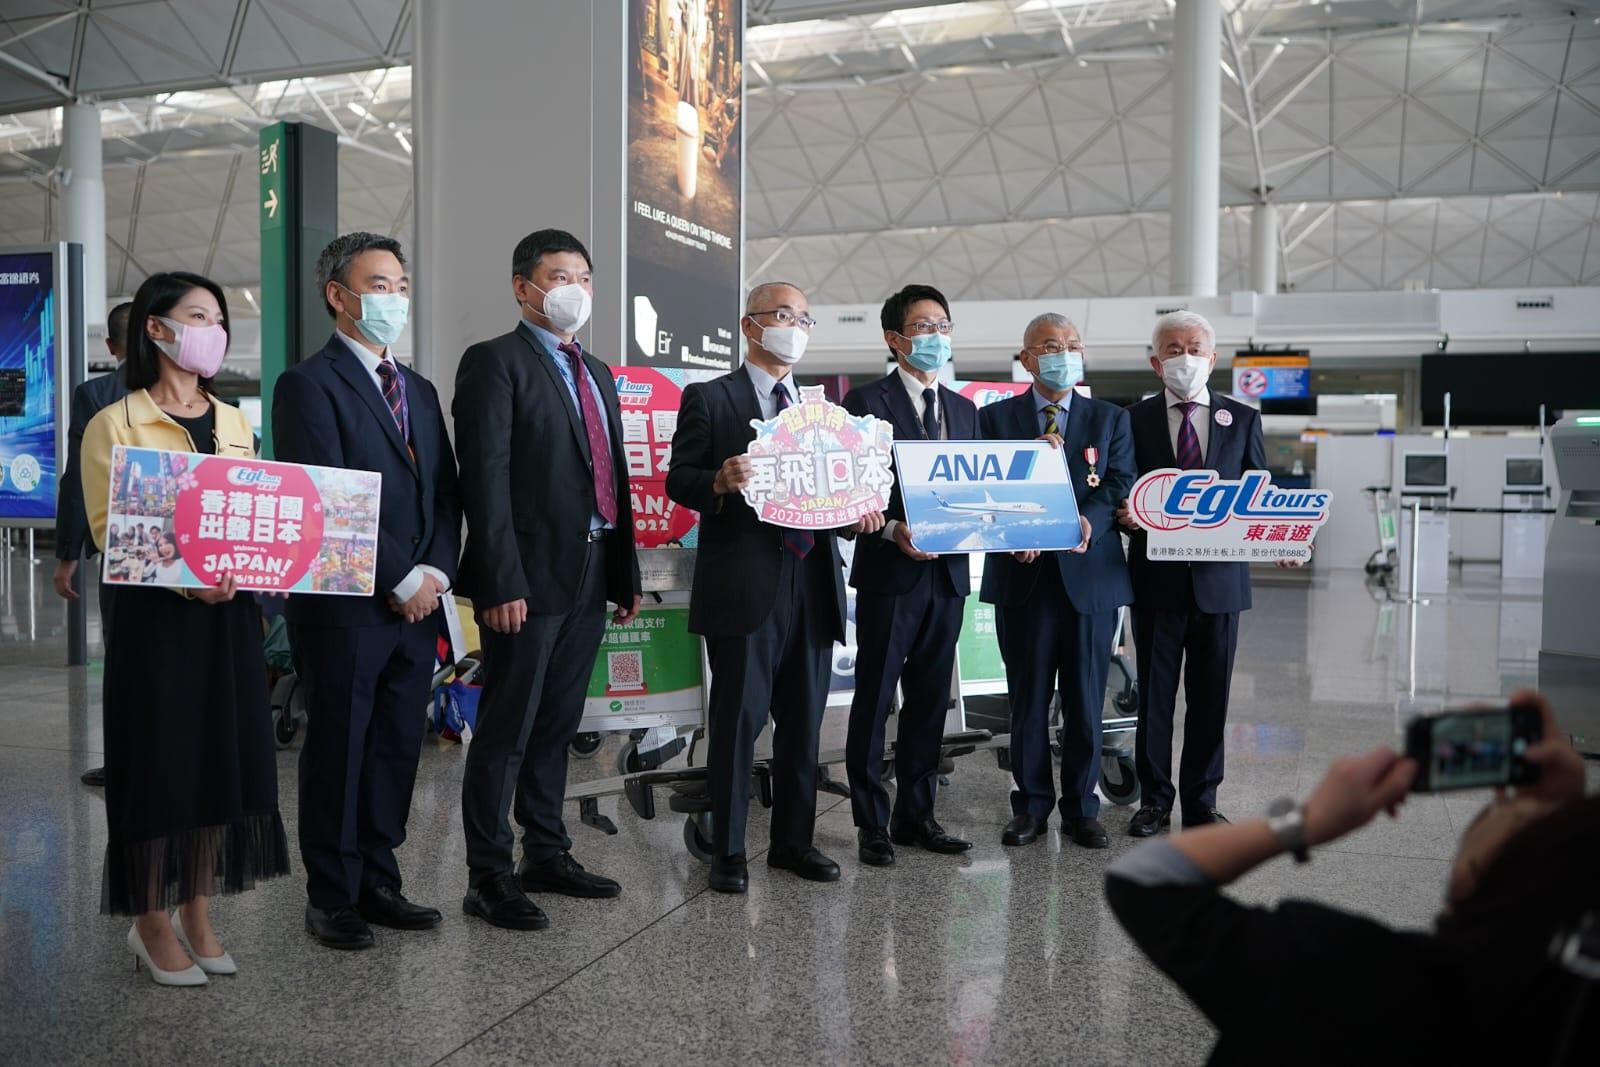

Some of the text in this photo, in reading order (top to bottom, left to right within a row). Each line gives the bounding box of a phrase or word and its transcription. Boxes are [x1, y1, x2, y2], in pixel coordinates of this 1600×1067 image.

[638, 202, 652, 219] FEEL
[652, 208, 666, 224] LIKE
[671, 216, 690, 233] QUEEN
[690, 223, 699, 236] ON
[626, 382, 651, 391] tours
[928, 454, 1004, 482] ANA
[200, 489, 304, 520] 香港首團
[800, 497, 848, 512] JAPAN!
[1262, 489, 1328, 508] tours
[198, 514, 302, 544] 出發日本
[1243, 524, 1314, 542] 東瀛遊
[1151, 547, 1246, 557] 香港聯合交易所主板上市
[202, 553, 293, 577] JAPAN!
